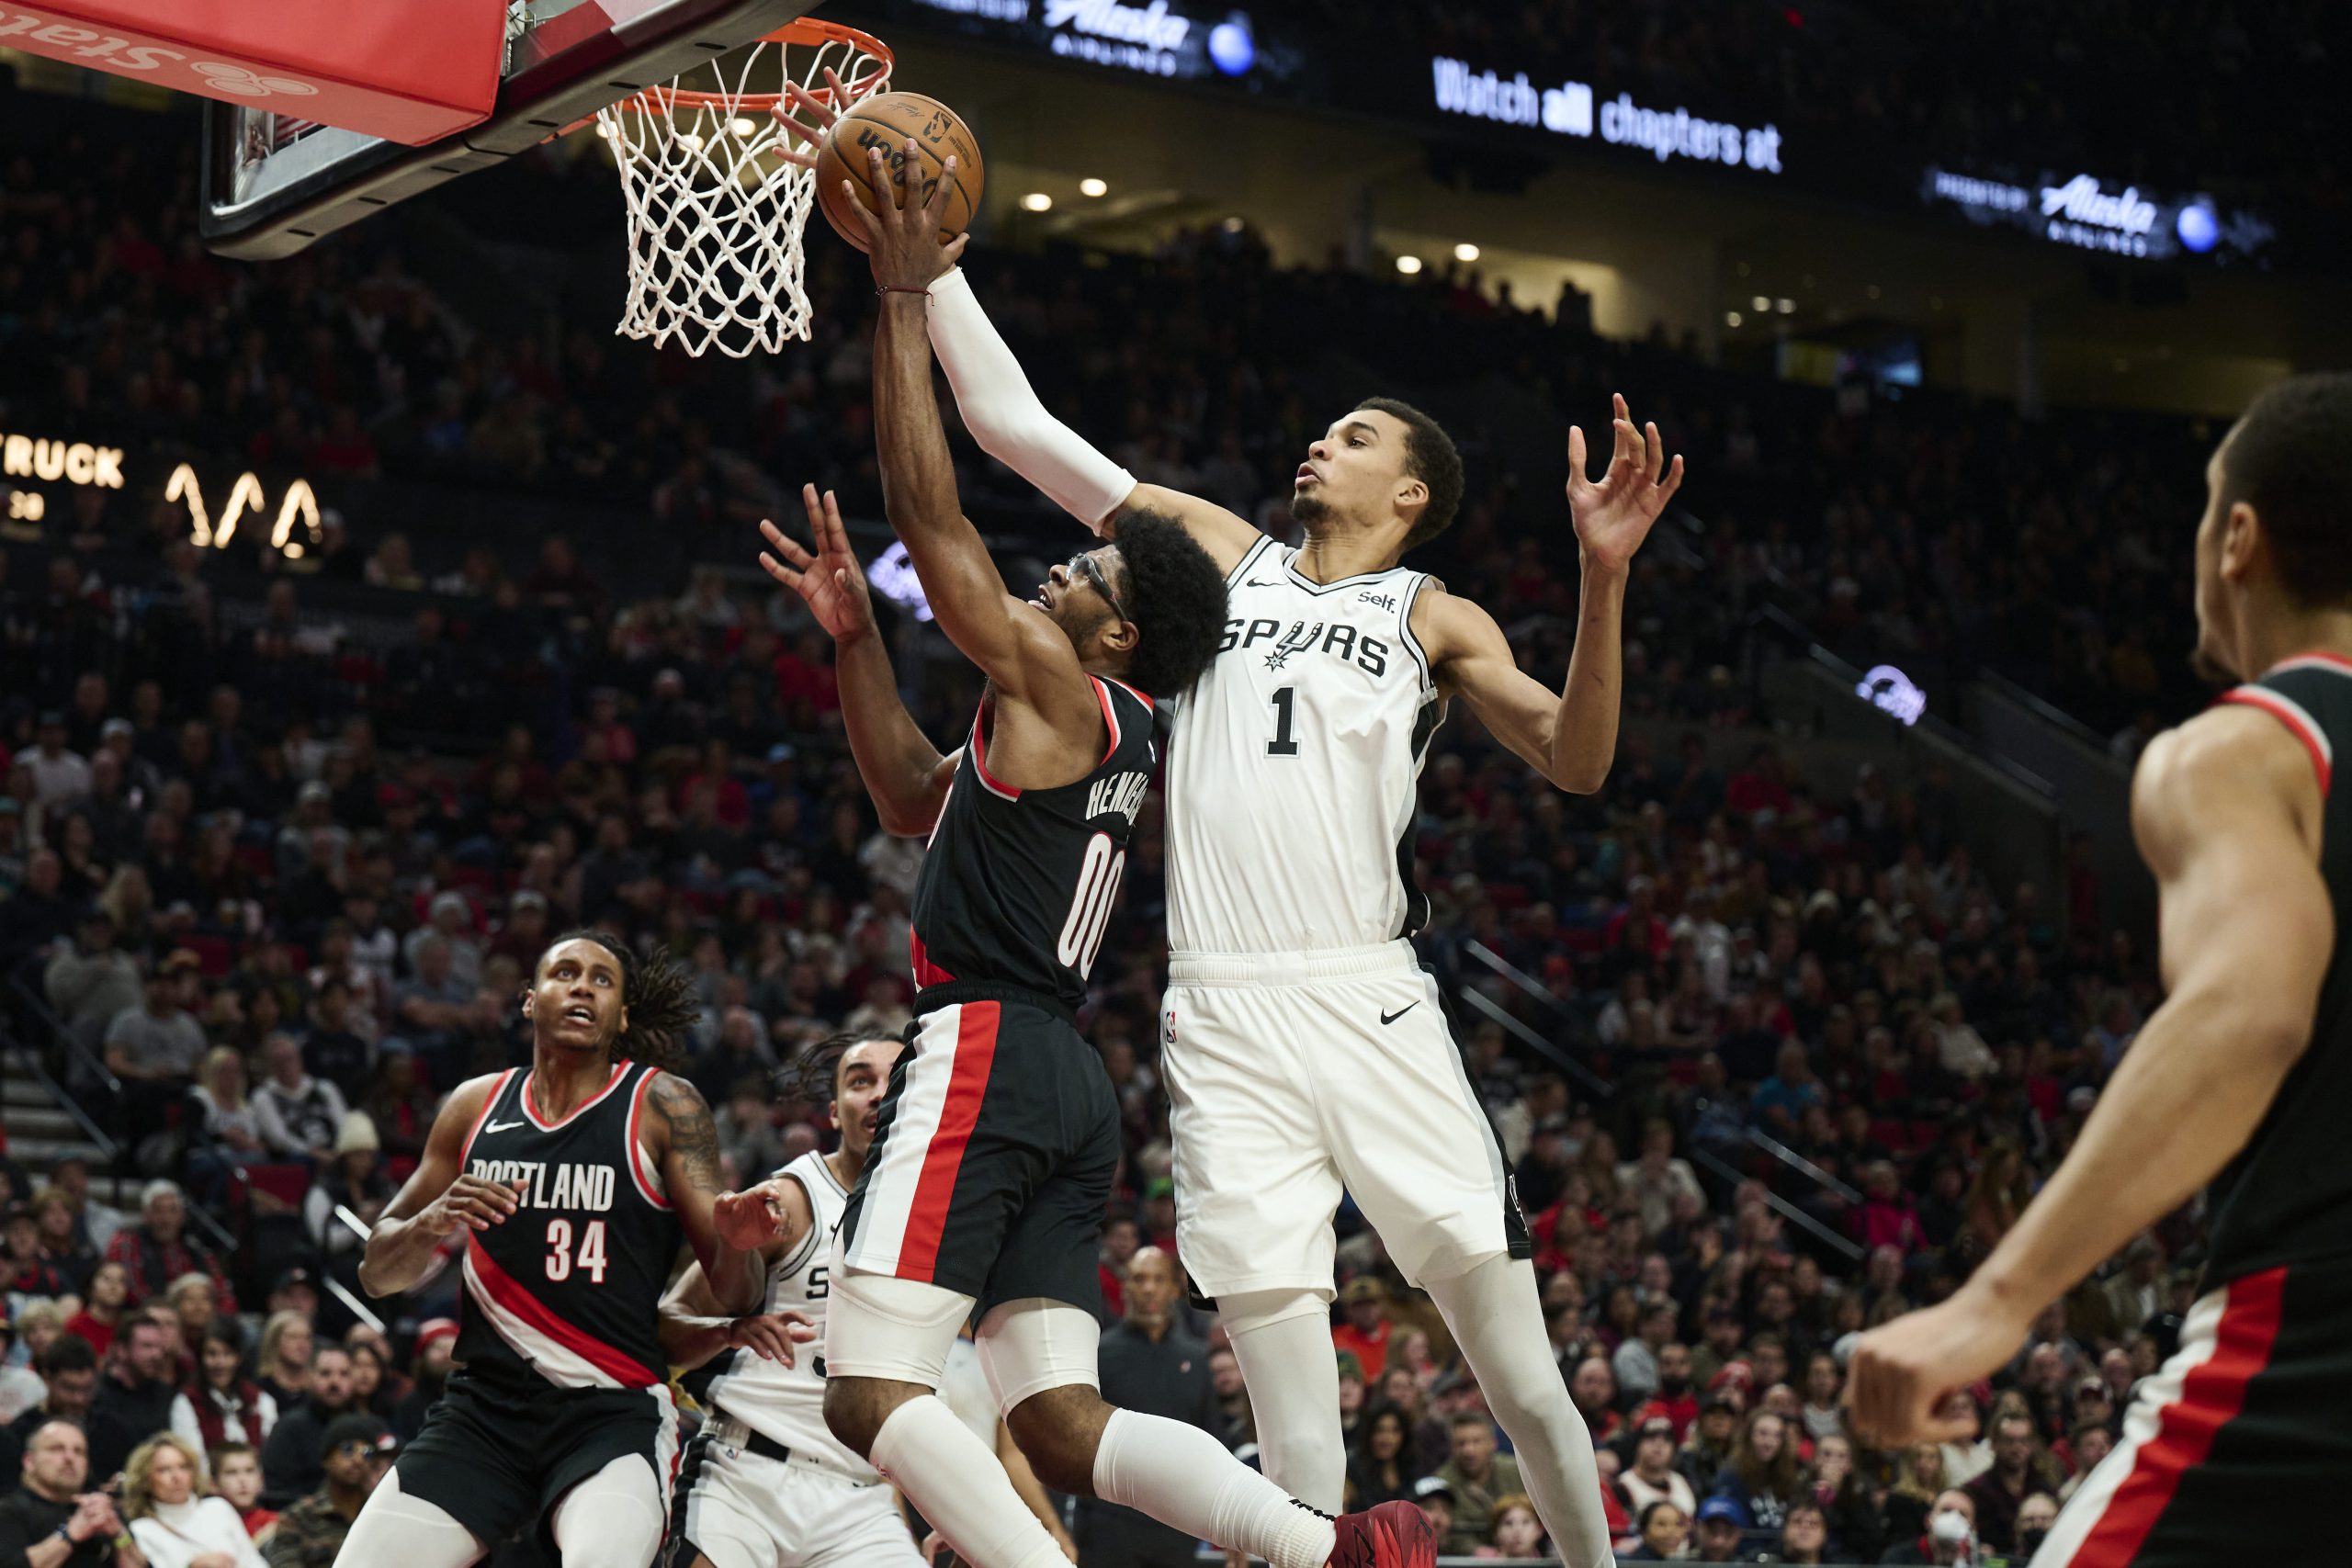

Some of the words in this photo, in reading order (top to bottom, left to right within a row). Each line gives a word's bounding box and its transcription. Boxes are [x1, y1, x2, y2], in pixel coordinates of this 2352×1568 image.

[1051, 33, 1176, 77] AIRLINES
[1433, 55, 1538, 128] Watch
[1543, 82, 1592, 137] all
[1600, 92, 1742, 163] chapters
[1745, 123, 1782, 174] at
[2041, 174, 2157, 236] Alaska
[2047, 220, 2147, 257] AIRLINES
[0, 433, 125, 490] RUCK
[1357, 591, 1396, 615] Self.
[1218, 618, 1389, 678] SPURS
[1264, 684, 1301, 759] 1
[1057, 830, 1125, 981] 00
[544, 1216, 608, 1284] 34
